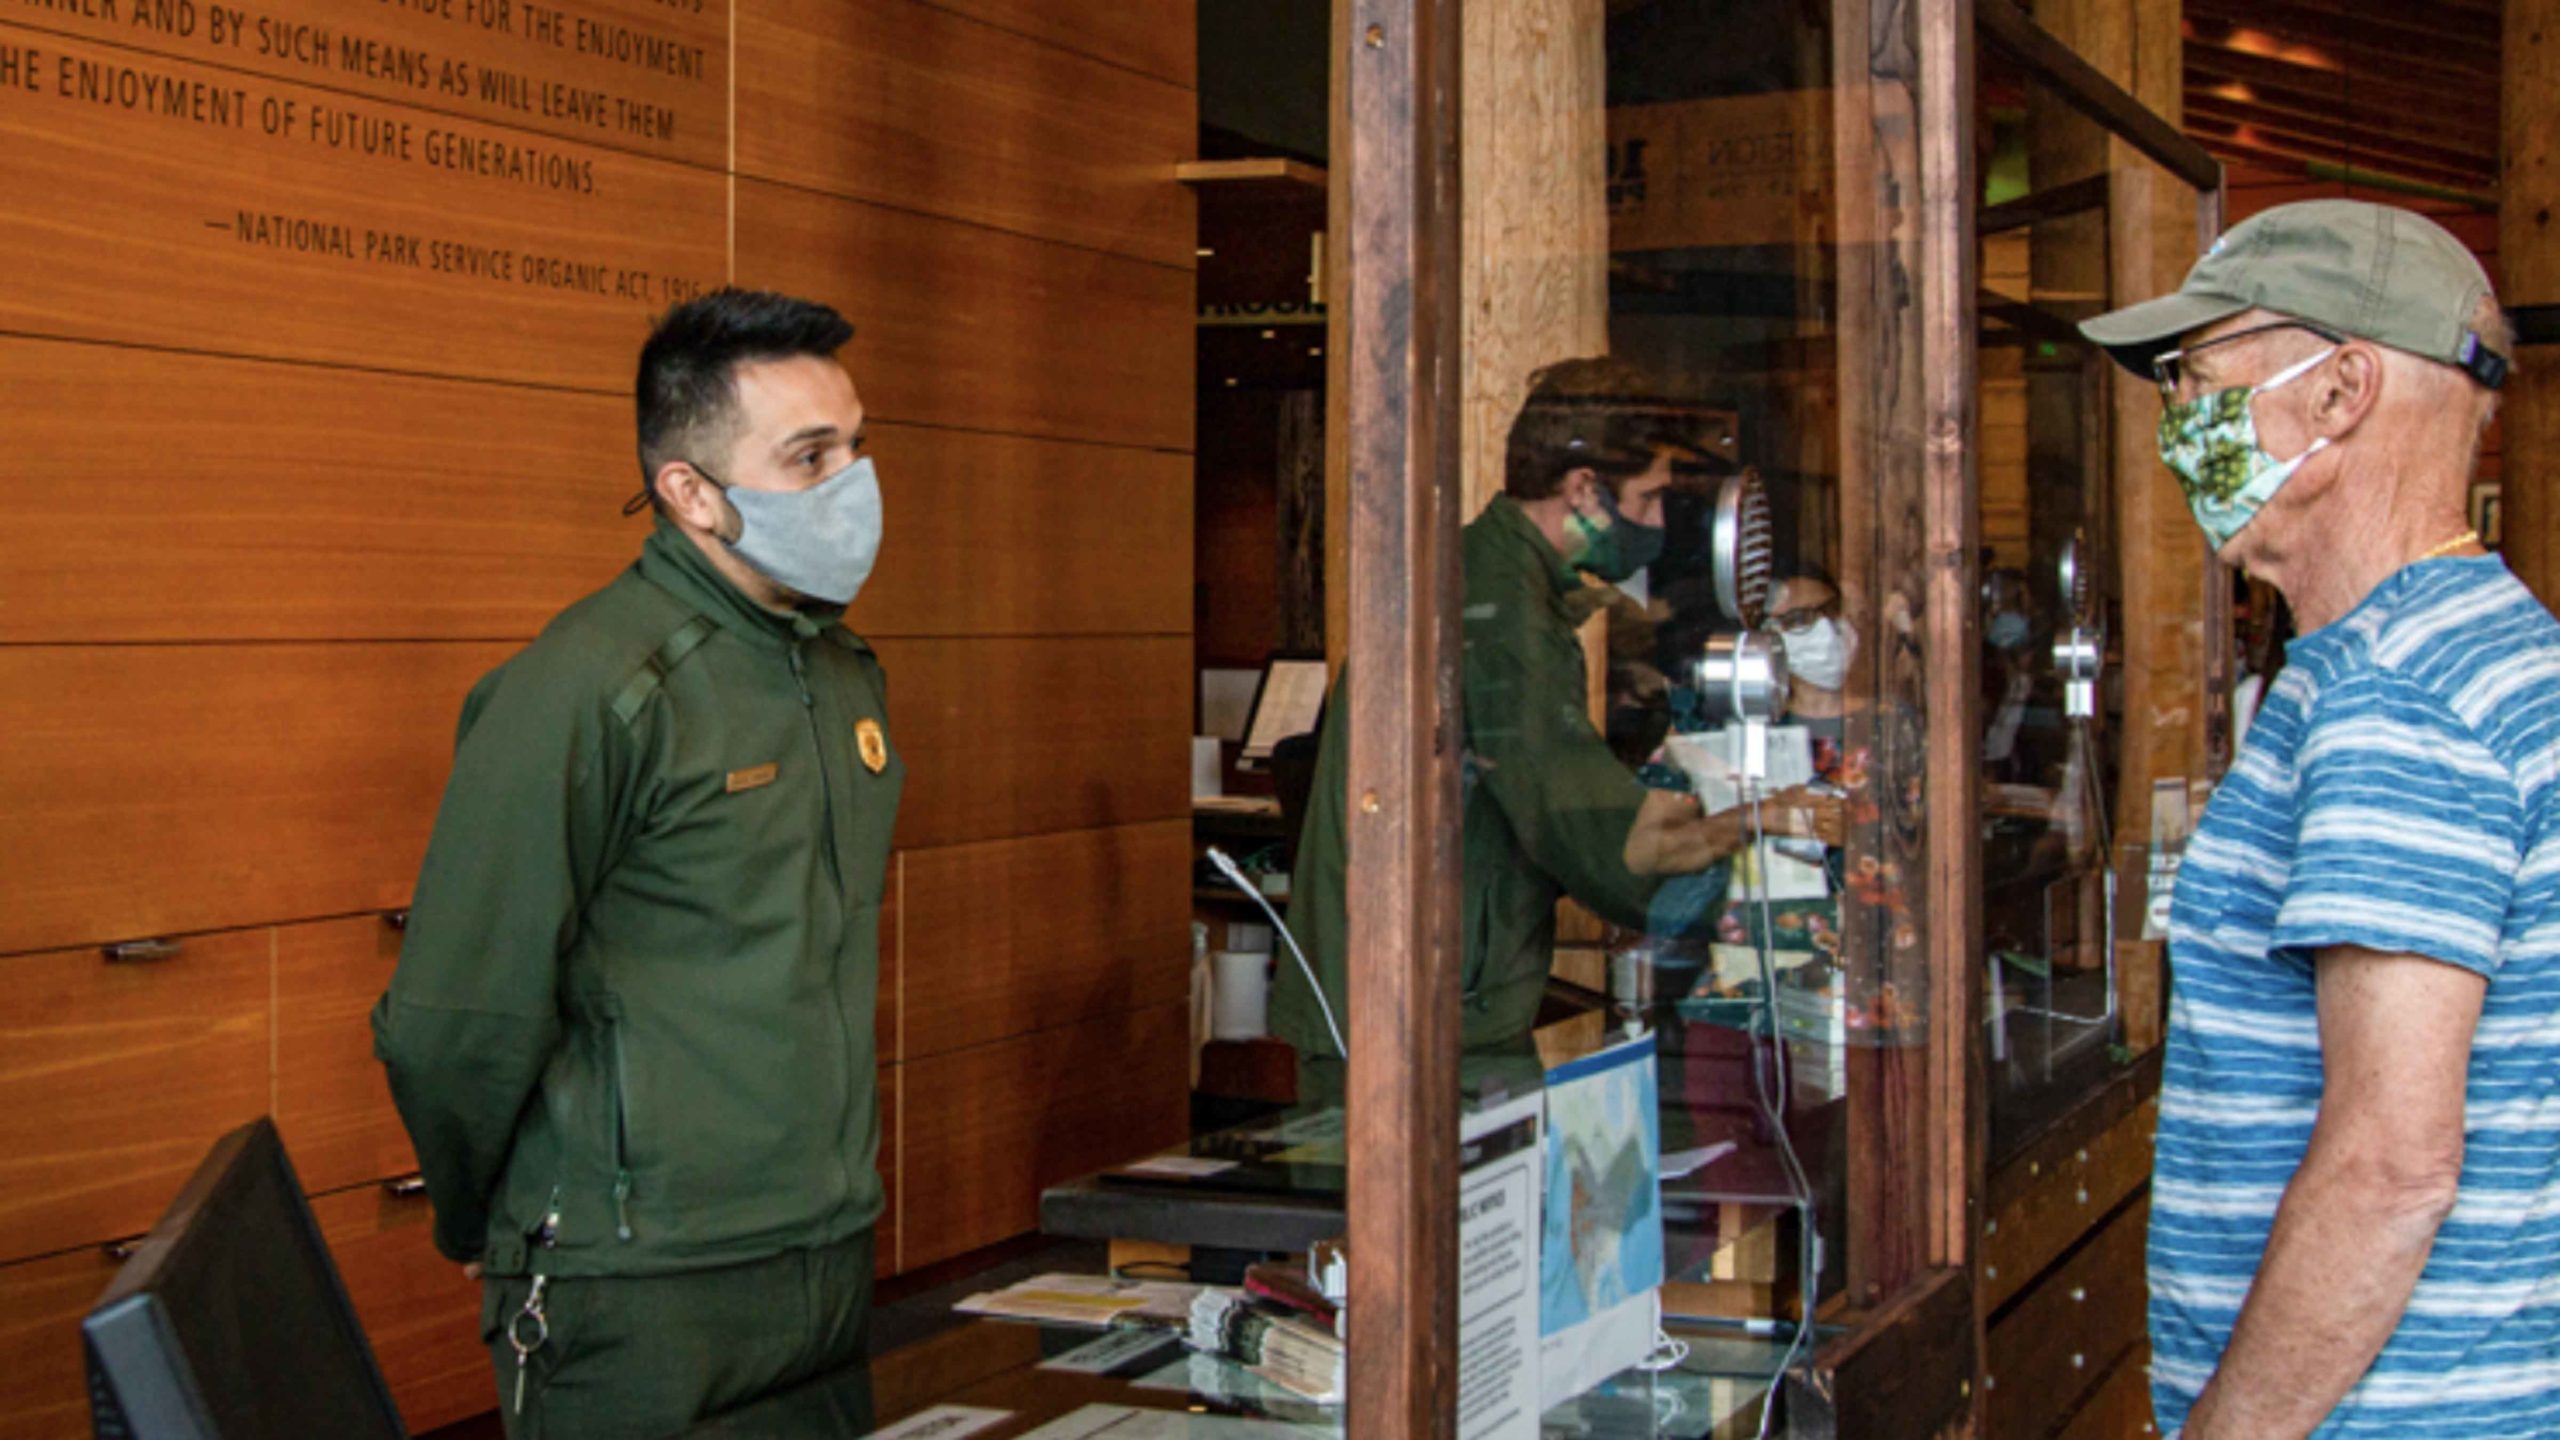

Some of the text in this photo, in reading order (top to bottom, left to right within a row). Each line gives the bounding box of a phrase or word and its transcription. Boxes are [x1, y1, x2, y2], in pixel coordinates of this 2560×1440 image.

[131, 0, 196, 37] AND
[210, 5, 244, 47] BY
[257, 16, 330, 67] SUCH
[341, 34, 430, 89] MEANS
[439, 59, 468, 97] AS
[478, 67, 530, 112] WILL
[541, 80, 607, 129] LEAVE
[616, 97, 674, 141] THEM
[466, 0, 511, 33] FOR
[523, 4, 565, 47] THE
[577, 17, 704, 81] ENJOYMENT
[59, 56, 247, 130] ENJOYMENT
[261, 96, 296, 137] OF
[311, 104, 412, 161] FUTURE
[424, 128, 600, 196] GENERATIONS.
[366, 229, 421, 268] PARK
[431, 239, 513, 282] SERVICE
[522, 254, 608, 296] ORGANIC
